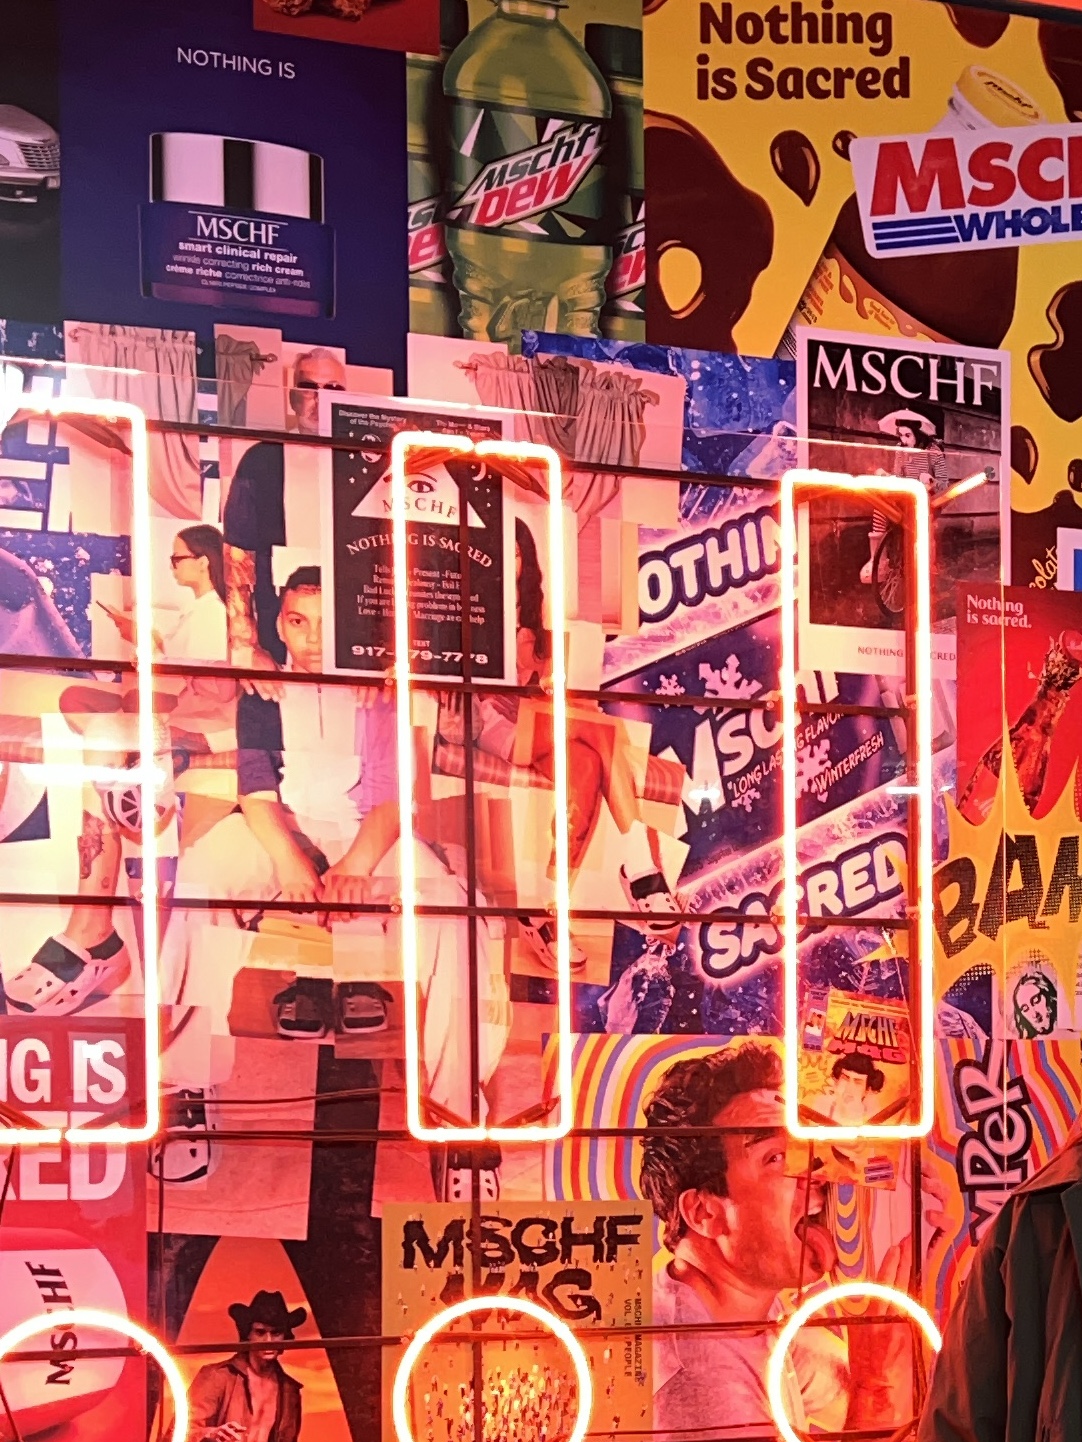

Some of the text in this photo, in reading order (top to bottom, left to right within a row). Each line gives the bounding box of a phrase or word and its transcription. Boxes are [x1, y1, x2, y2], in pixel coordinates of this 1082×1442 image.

[699, 1, 893, 56] Nothing
[176, 47, 296, 79] NOTHING IS
[696, 55, 910, 100] is Sacred
[197, 216, 280, 245] MSCHF
[178, 241, 298, 264] smart clinical repair
[251, 261, 272, 273] rich
[813, 344, 998, 406] MSCHF
[423, 534, 436, 547] IS
[967, 610, 979, 623] is
[857, 646, 956, 662] NOTHING CRED
[815, 731, 884, 792] WINTERFRESH
[73, 1039, 127, 1105] IS
[402, 1214, 643, 1269] MSCHF
